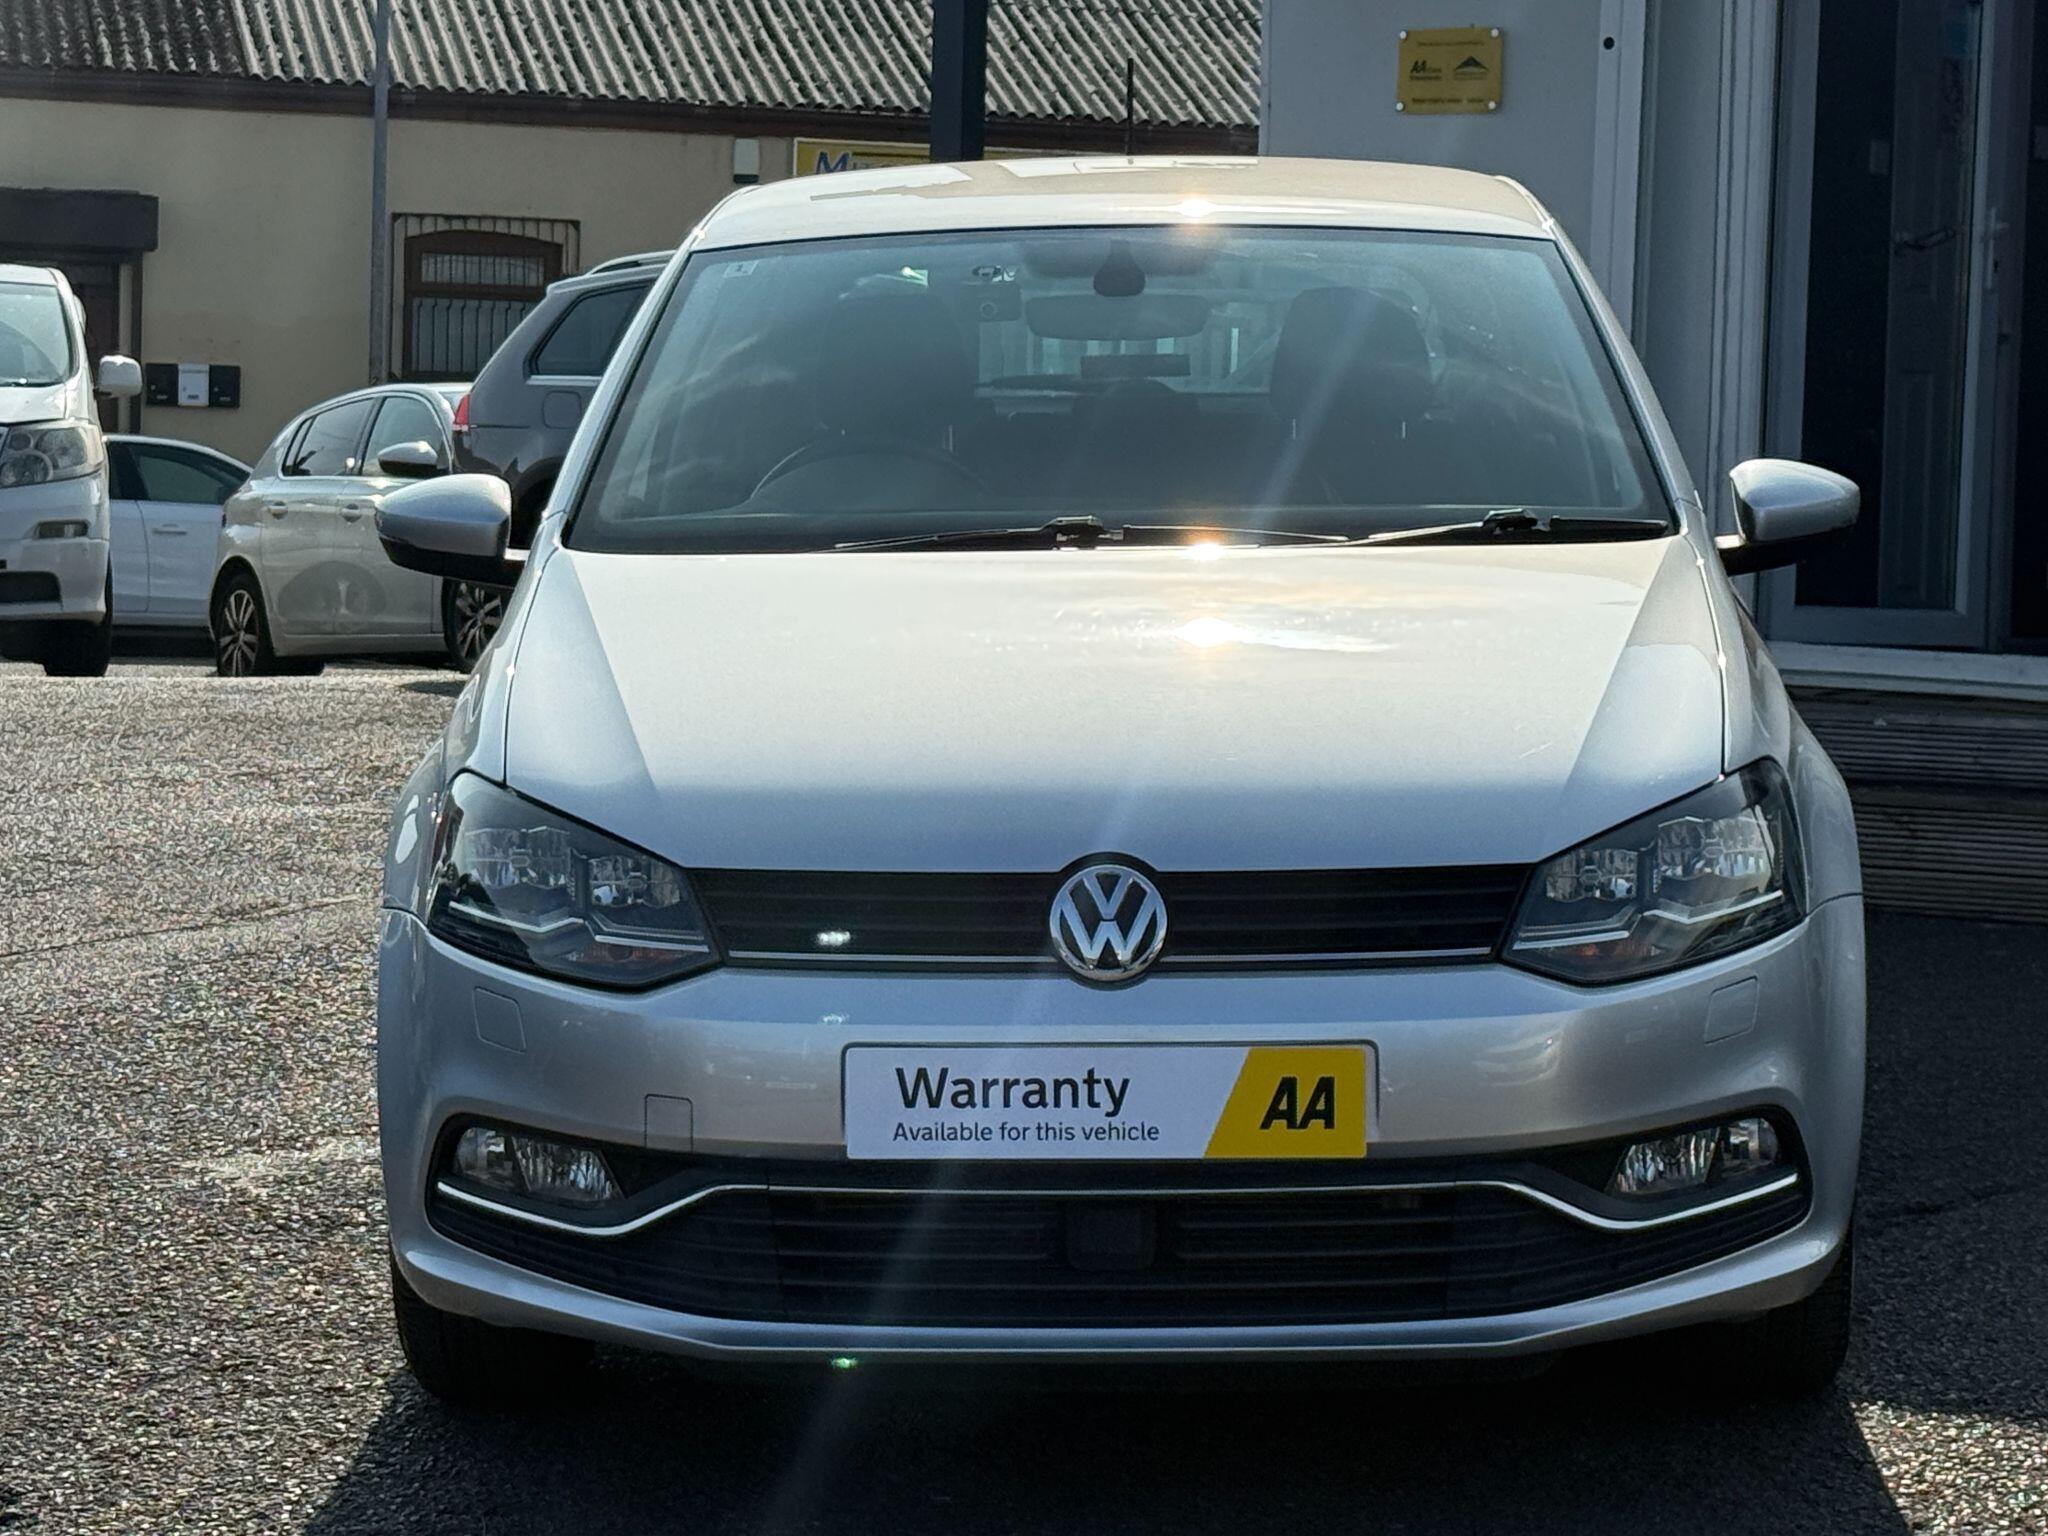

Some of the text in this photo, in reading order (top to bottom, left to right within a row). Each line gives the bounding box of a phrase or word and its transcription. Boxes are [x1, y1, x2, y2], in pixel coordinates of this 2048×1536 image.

[1051, 866, 1167, 980] VW
[895, 1066, 1131, 1118] Warranty
[1259, 1075, 1335, 1130] AA
[893, 1121, 1160, 1142] Available for this vehicle
